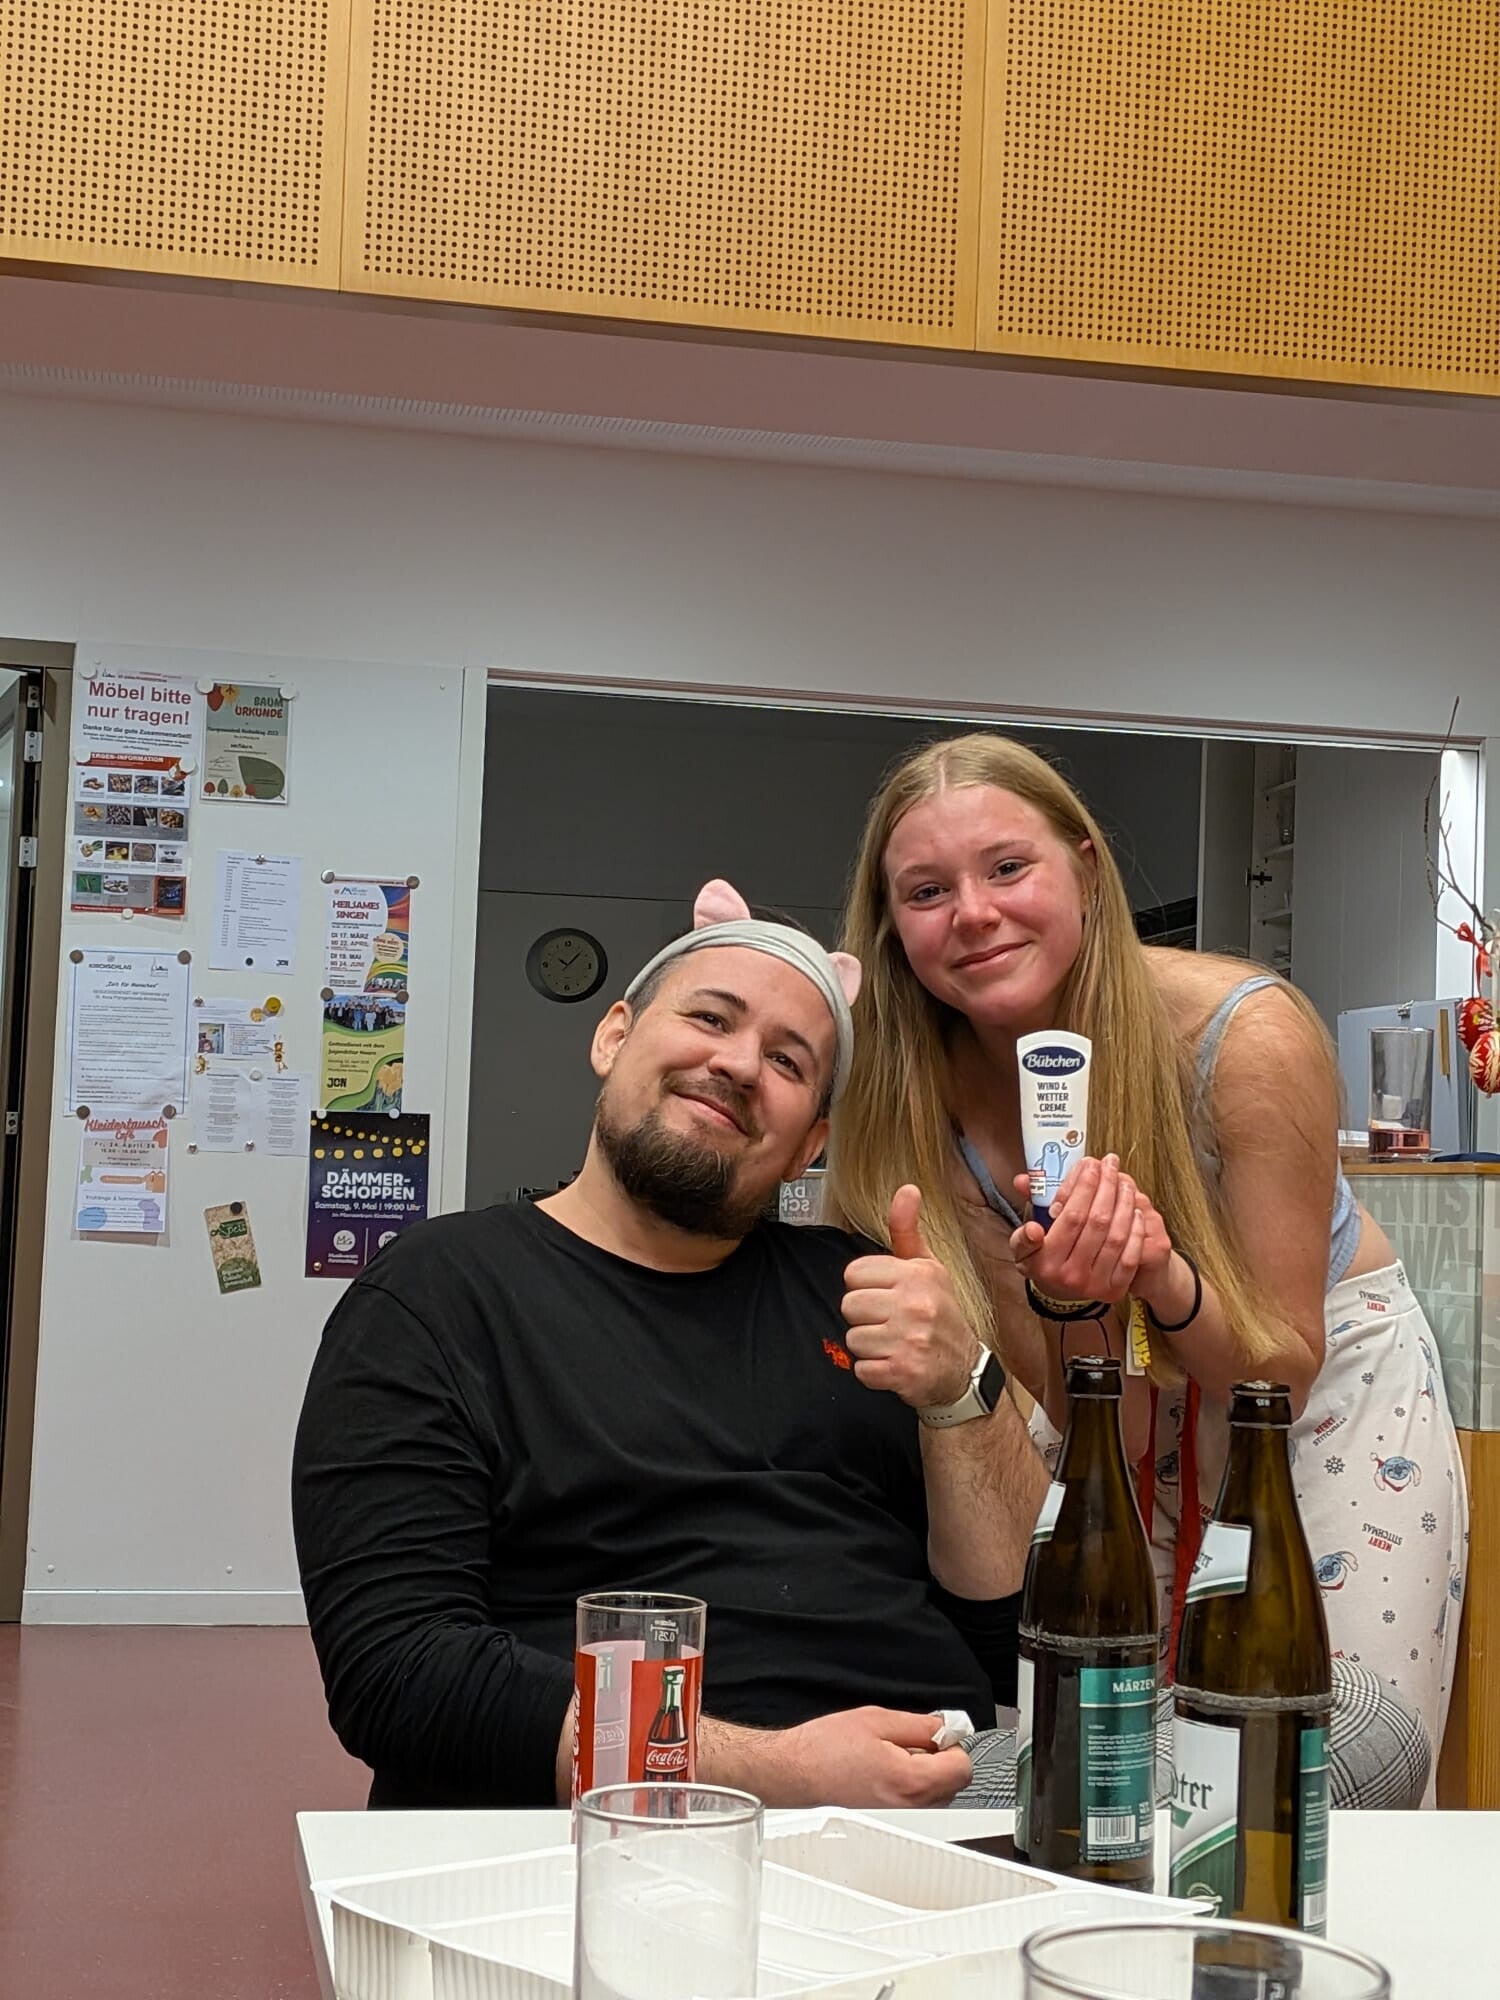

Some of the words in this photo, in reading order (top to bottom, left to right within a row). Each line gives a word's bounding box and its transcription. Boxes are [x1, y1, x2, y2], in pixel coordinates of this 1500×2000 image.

[89, 681, 145, 701] Möbel
[151, 687, 192, 705] bitte
[254, 696, 283, 707] BAUM
[88, 704, 119, 718] nur
[124, 706, 190, 726] tragen!
[235, 706, 283, 718] URKUNDE
[82, 723, 102, 731] Danke
[332, 900, 380, 910] HEILSAMES
[336, 911, 369, 920] SINGEN
[350, 932, 369, 940] MÄRZ
[1025, 1054, 1081, 1069] Bübchen
[1037, 1082, 1060, 1090] WIND
[1061, 1082, 1068, 1090] &
[1036, 1092, 1069, 1102] WETTER
[1039, 1103, 1067, 1112] CREME
[84, 1117, 167, 1132] Kleidertausch
[327, 1168, 411, 1186] DÄMMER-
[321, 1185, 415, 1200] SCHOPPEN
[315, 1201, 352, 1211] Samstag,
[384, 1203, 405, 1211] 19:00
[1312, 1416, 1348, 1447] STITCHMAS
[1314, 1416, 1336, 1436] MERRY
[1362, 1523, 1403, 1546] STITCHMAS
[1368, 1537, 1393, 1552] MERRY
[1112, 1678, 1156, 1693] MÄRZEN
